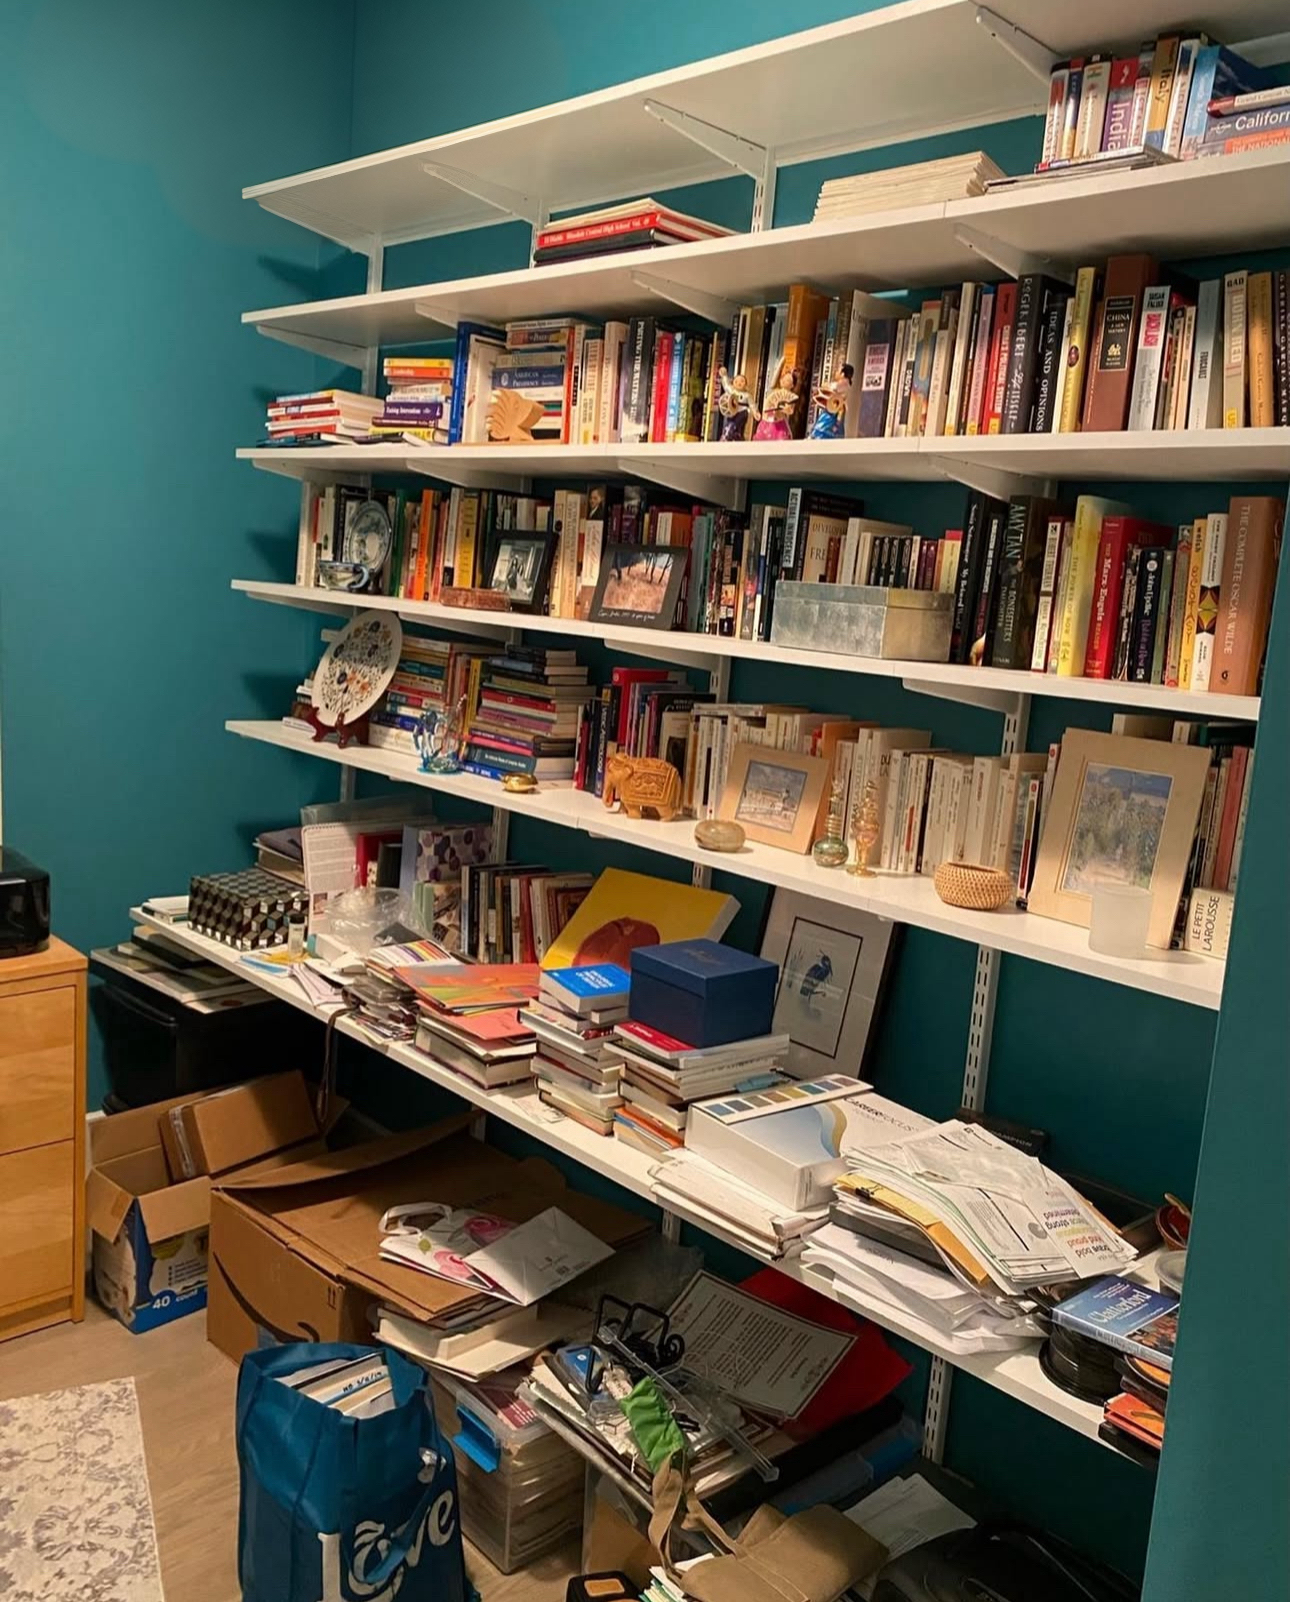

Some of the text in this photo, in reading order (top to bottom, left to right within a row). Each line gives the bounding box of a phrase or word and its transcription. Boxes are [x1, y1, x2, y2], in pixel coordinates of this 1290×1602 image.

[1153, 69, 1173, 104] Italy
[1107, 101, 1131, 151] India
[1018, 278, 1033, 321] ROGER
[1106, 313, 1130, 323] CHINA
[825, 338, 834, 357] BLACK
[1014, 322, 1028, 358] EBERT
[1034, 310, 1058, 432] IDEAS AND OPINIONS
[1006, 502, 1026, 560] AMY TAN
[1224, 505, 1251, 655] THE COMPLETE OSCAR WILDE
[1194, 902, 1206, 929] PETIT
[1202, 896, 1220, 952] LAROUSSE
[1045, 1219, 1069, 1231] strong
[1066, 1237, 1087, 1248] proud
[1075, 1247, 1092, 1259] bold
[152, 1289, 198, 1310] 40 count
